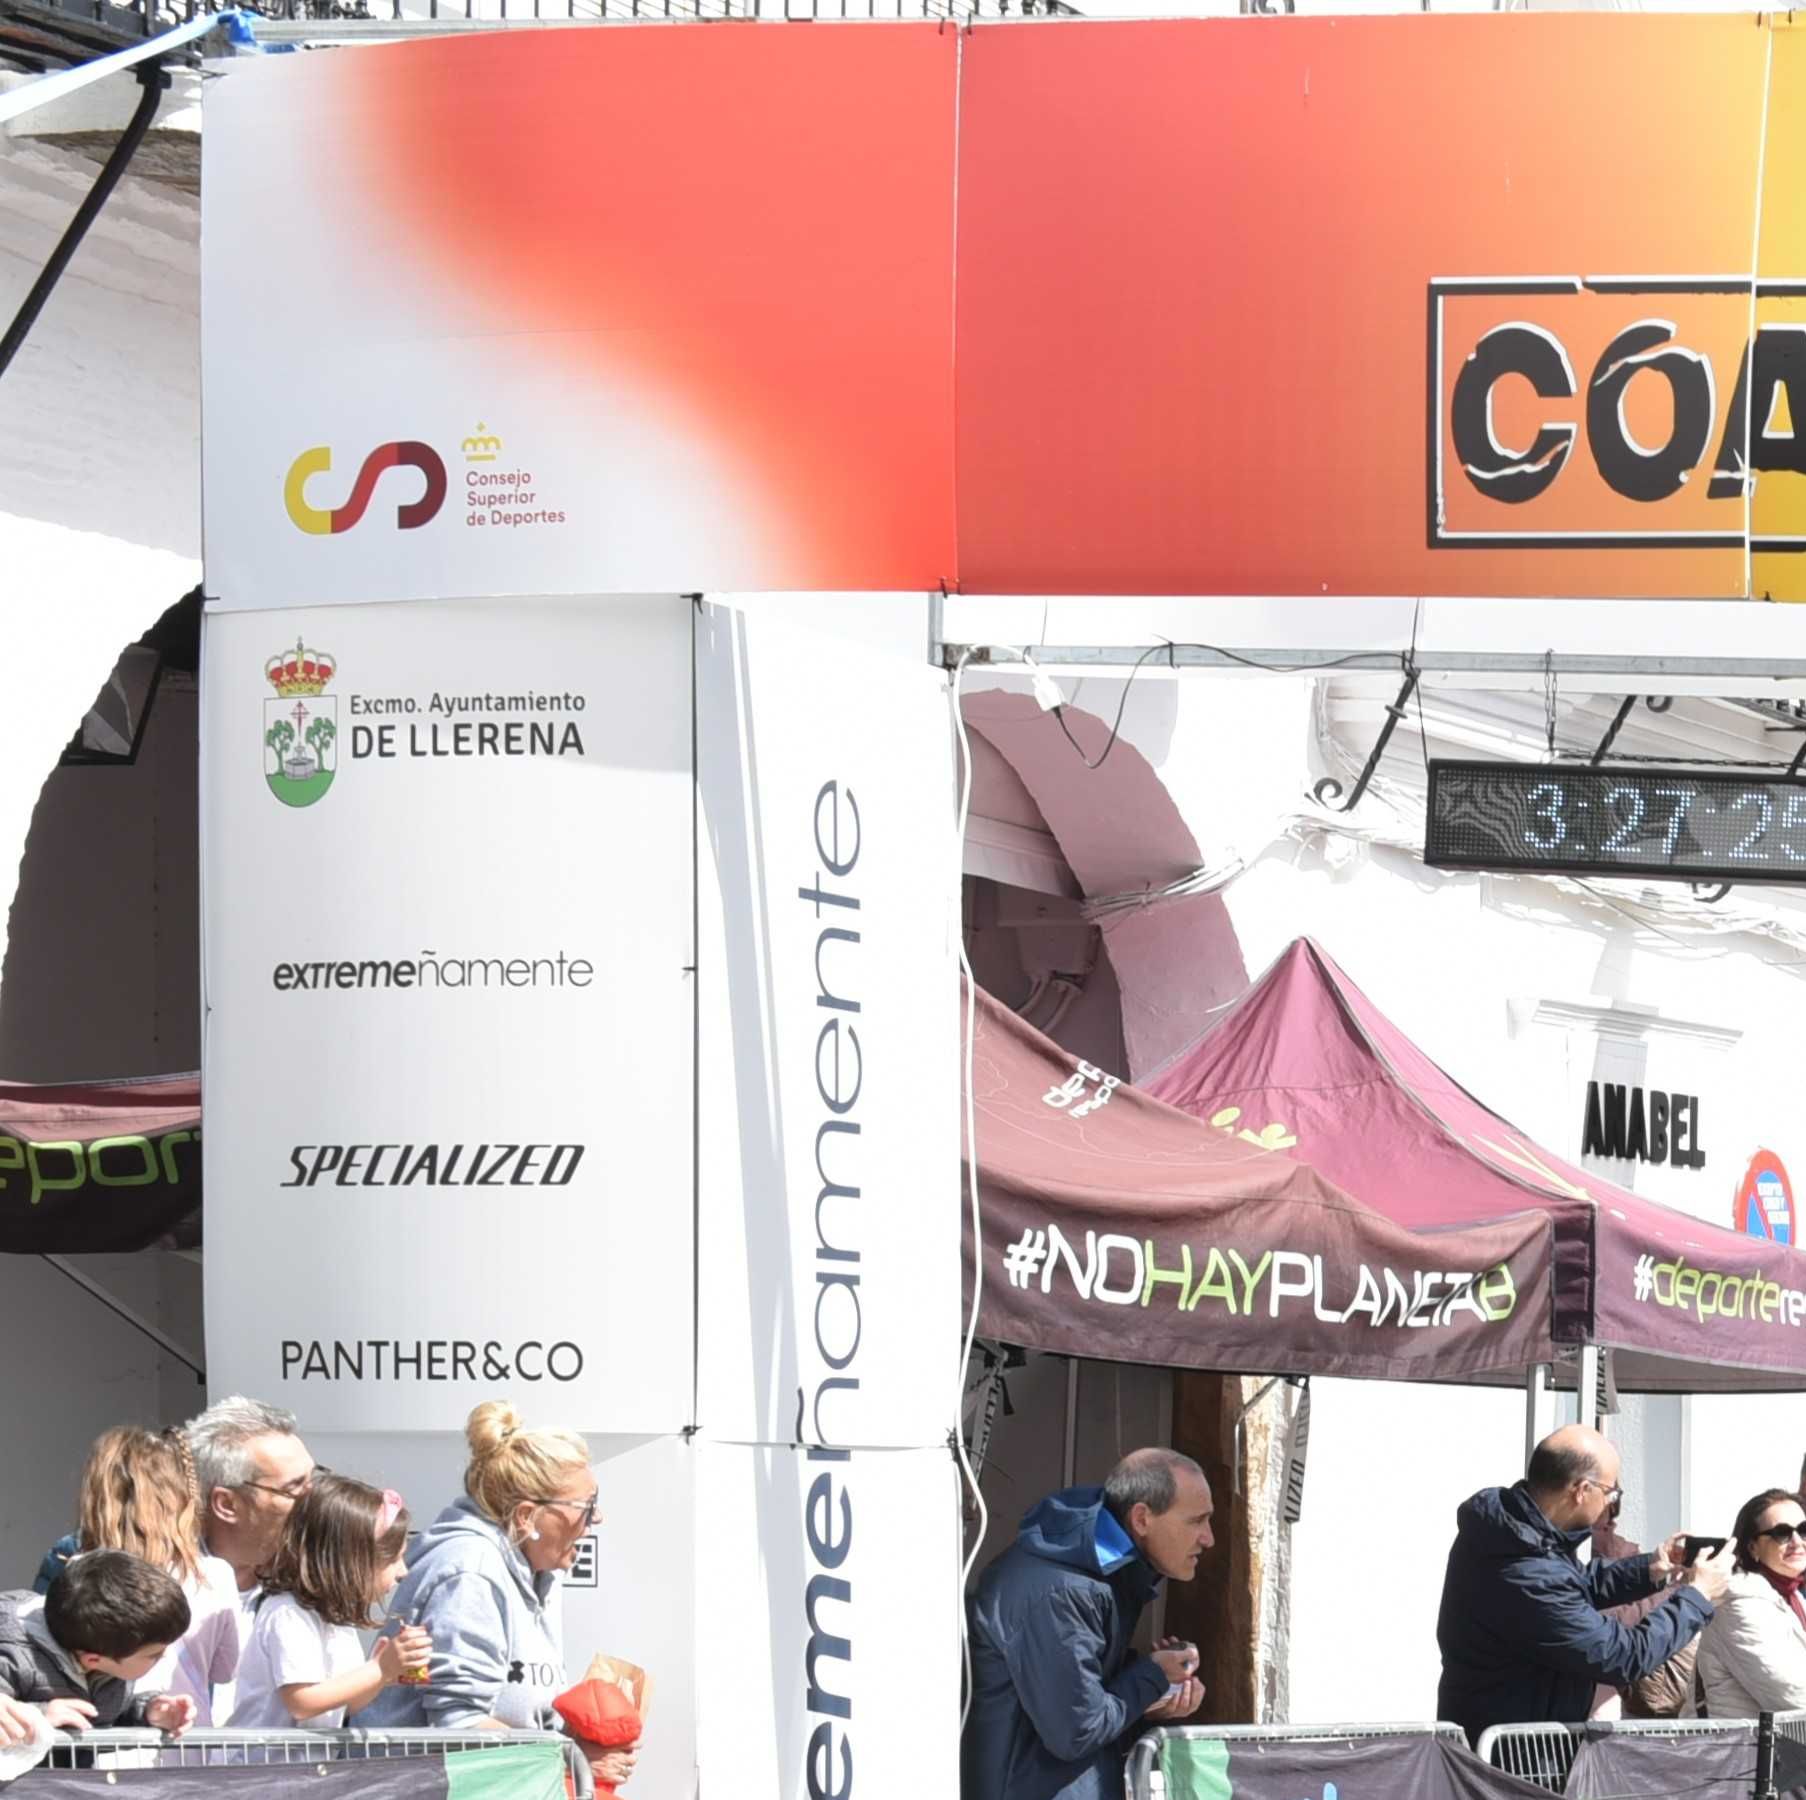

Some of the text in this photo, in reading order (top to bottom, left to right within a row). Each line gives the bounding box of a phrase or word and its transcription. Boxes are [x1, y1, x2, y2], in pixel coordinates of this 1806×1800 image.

[466, 470, 532, 487] Consejo
[466, 488, 536, 507] Superior
[466, 508, 566, 528] de Deportes
[350, 690, 586, 719] Excmo. Ayuntamiento
[351, 721, 586, 759] DE LLERENA
[272, 949, 594, 991] extremeñamente
[1581, 1080, 1707, 1170] ANABEL
[280, 1144, 586, 1188] SPECIALIZED
[281, 1340, 584, 1382] PANTHER&CO
